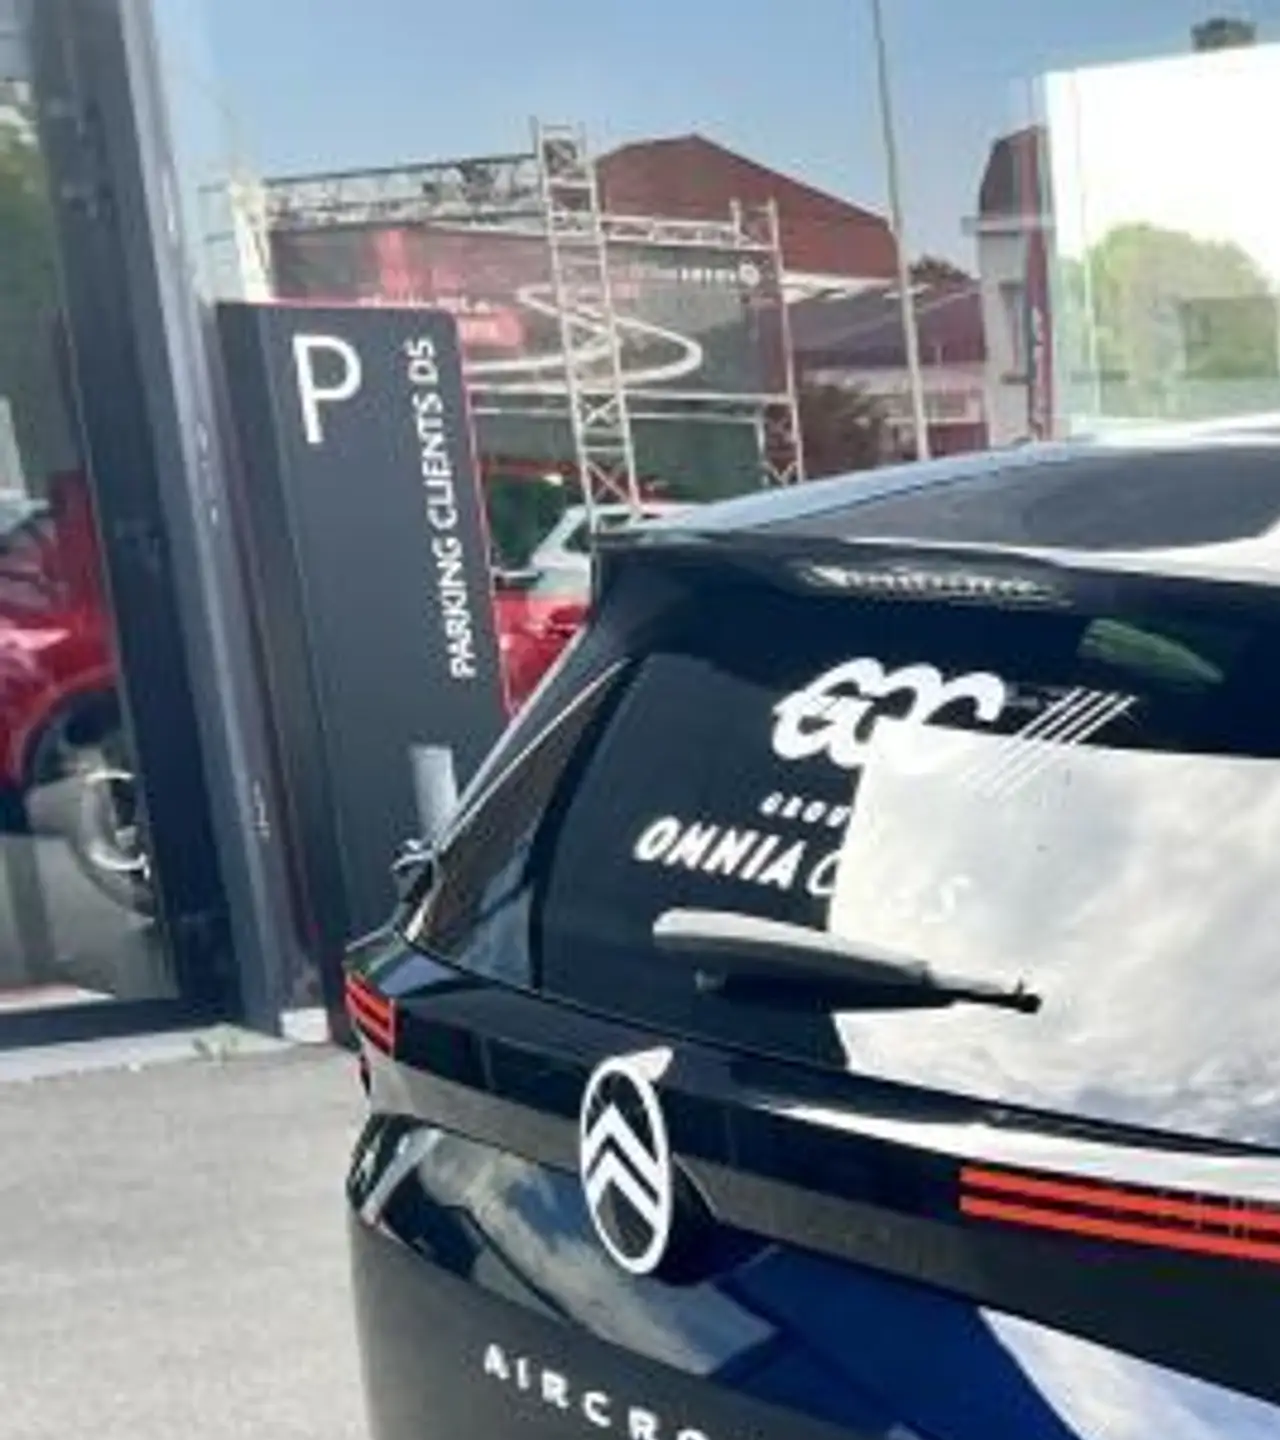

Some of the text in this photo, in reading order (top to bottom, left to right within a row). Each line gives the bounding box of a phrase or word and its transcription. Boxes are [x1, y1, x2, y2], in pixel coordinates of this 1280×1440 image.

[291, 333, 362, 445] P
[412, 393, 458, 531] CLIENTS
[432, 537, 476, 678] PARKING
[634, 816, 807, 891] OMNIA
